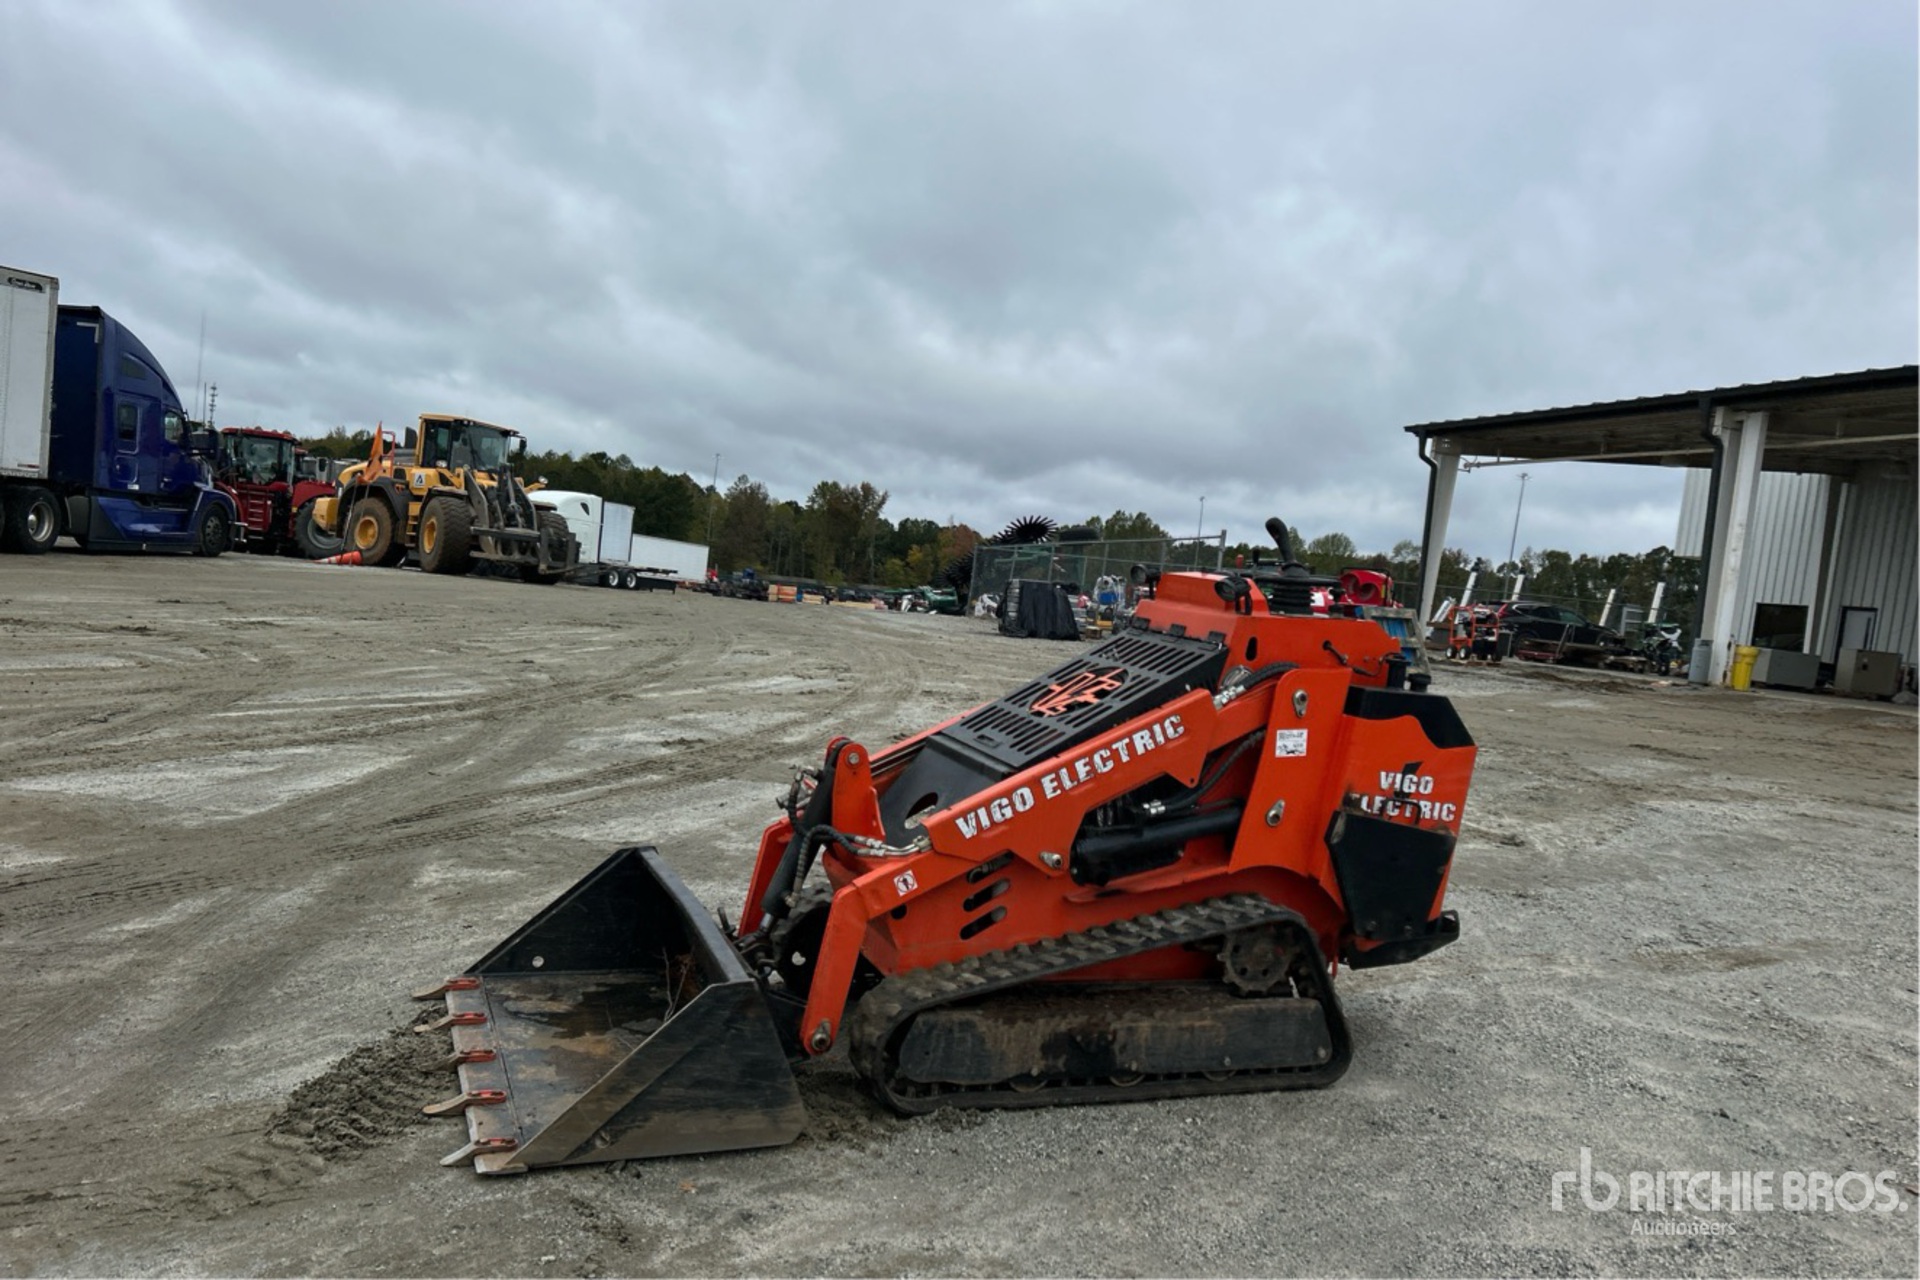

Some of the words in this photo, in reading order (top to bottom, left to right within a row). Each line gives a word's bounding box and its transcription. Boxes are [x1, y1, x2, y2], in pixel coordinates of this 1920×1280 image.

[955, 786, 1035, 840] VIGO
[1040, 714, 1185, 800] ELECTRIC
[1379, 771, 1434, 795] VIGO
[1349, 792, 1457, 822] LECTRIC
